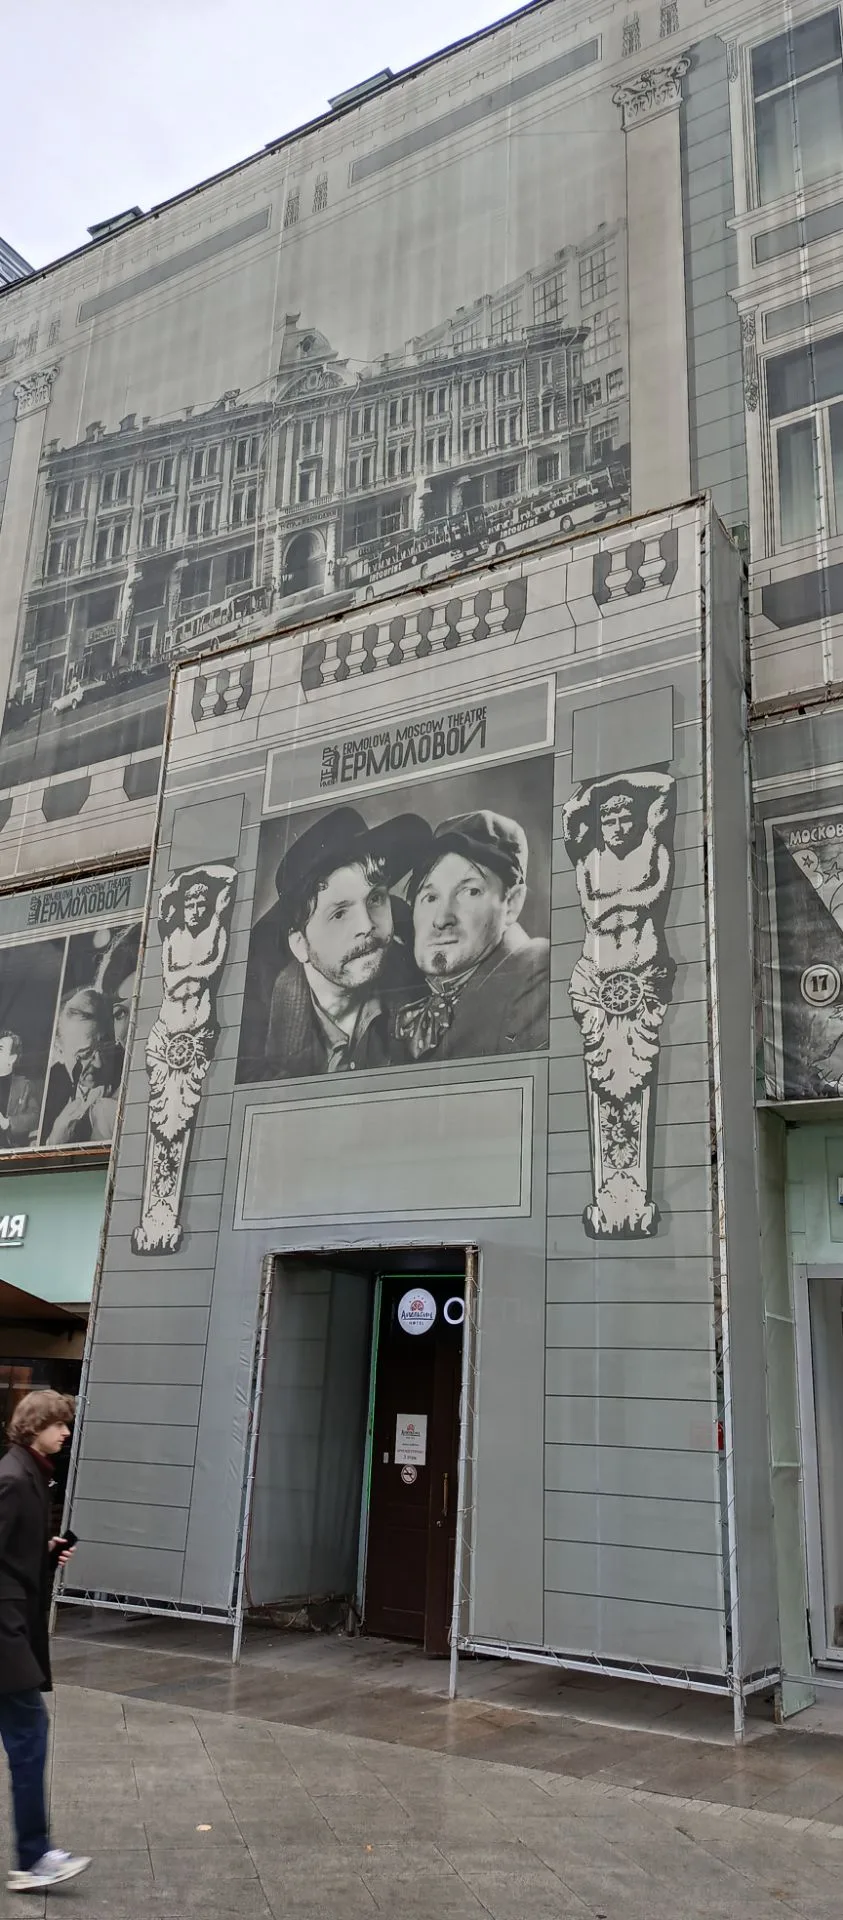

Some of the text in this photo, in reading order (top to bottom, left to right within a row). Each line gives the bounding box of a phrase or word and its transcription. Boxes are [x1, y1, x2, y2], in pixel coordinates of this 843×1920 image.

[341, 720, 487, 783] ЕРМОЛОВОЙ
[343, 706, 487, 755] ERMOLOVA MOSCOW THEATRE
[40, 884, 132, 923] ЕРМОЛОВОЙ
[811, 975, 829, 992] 17
